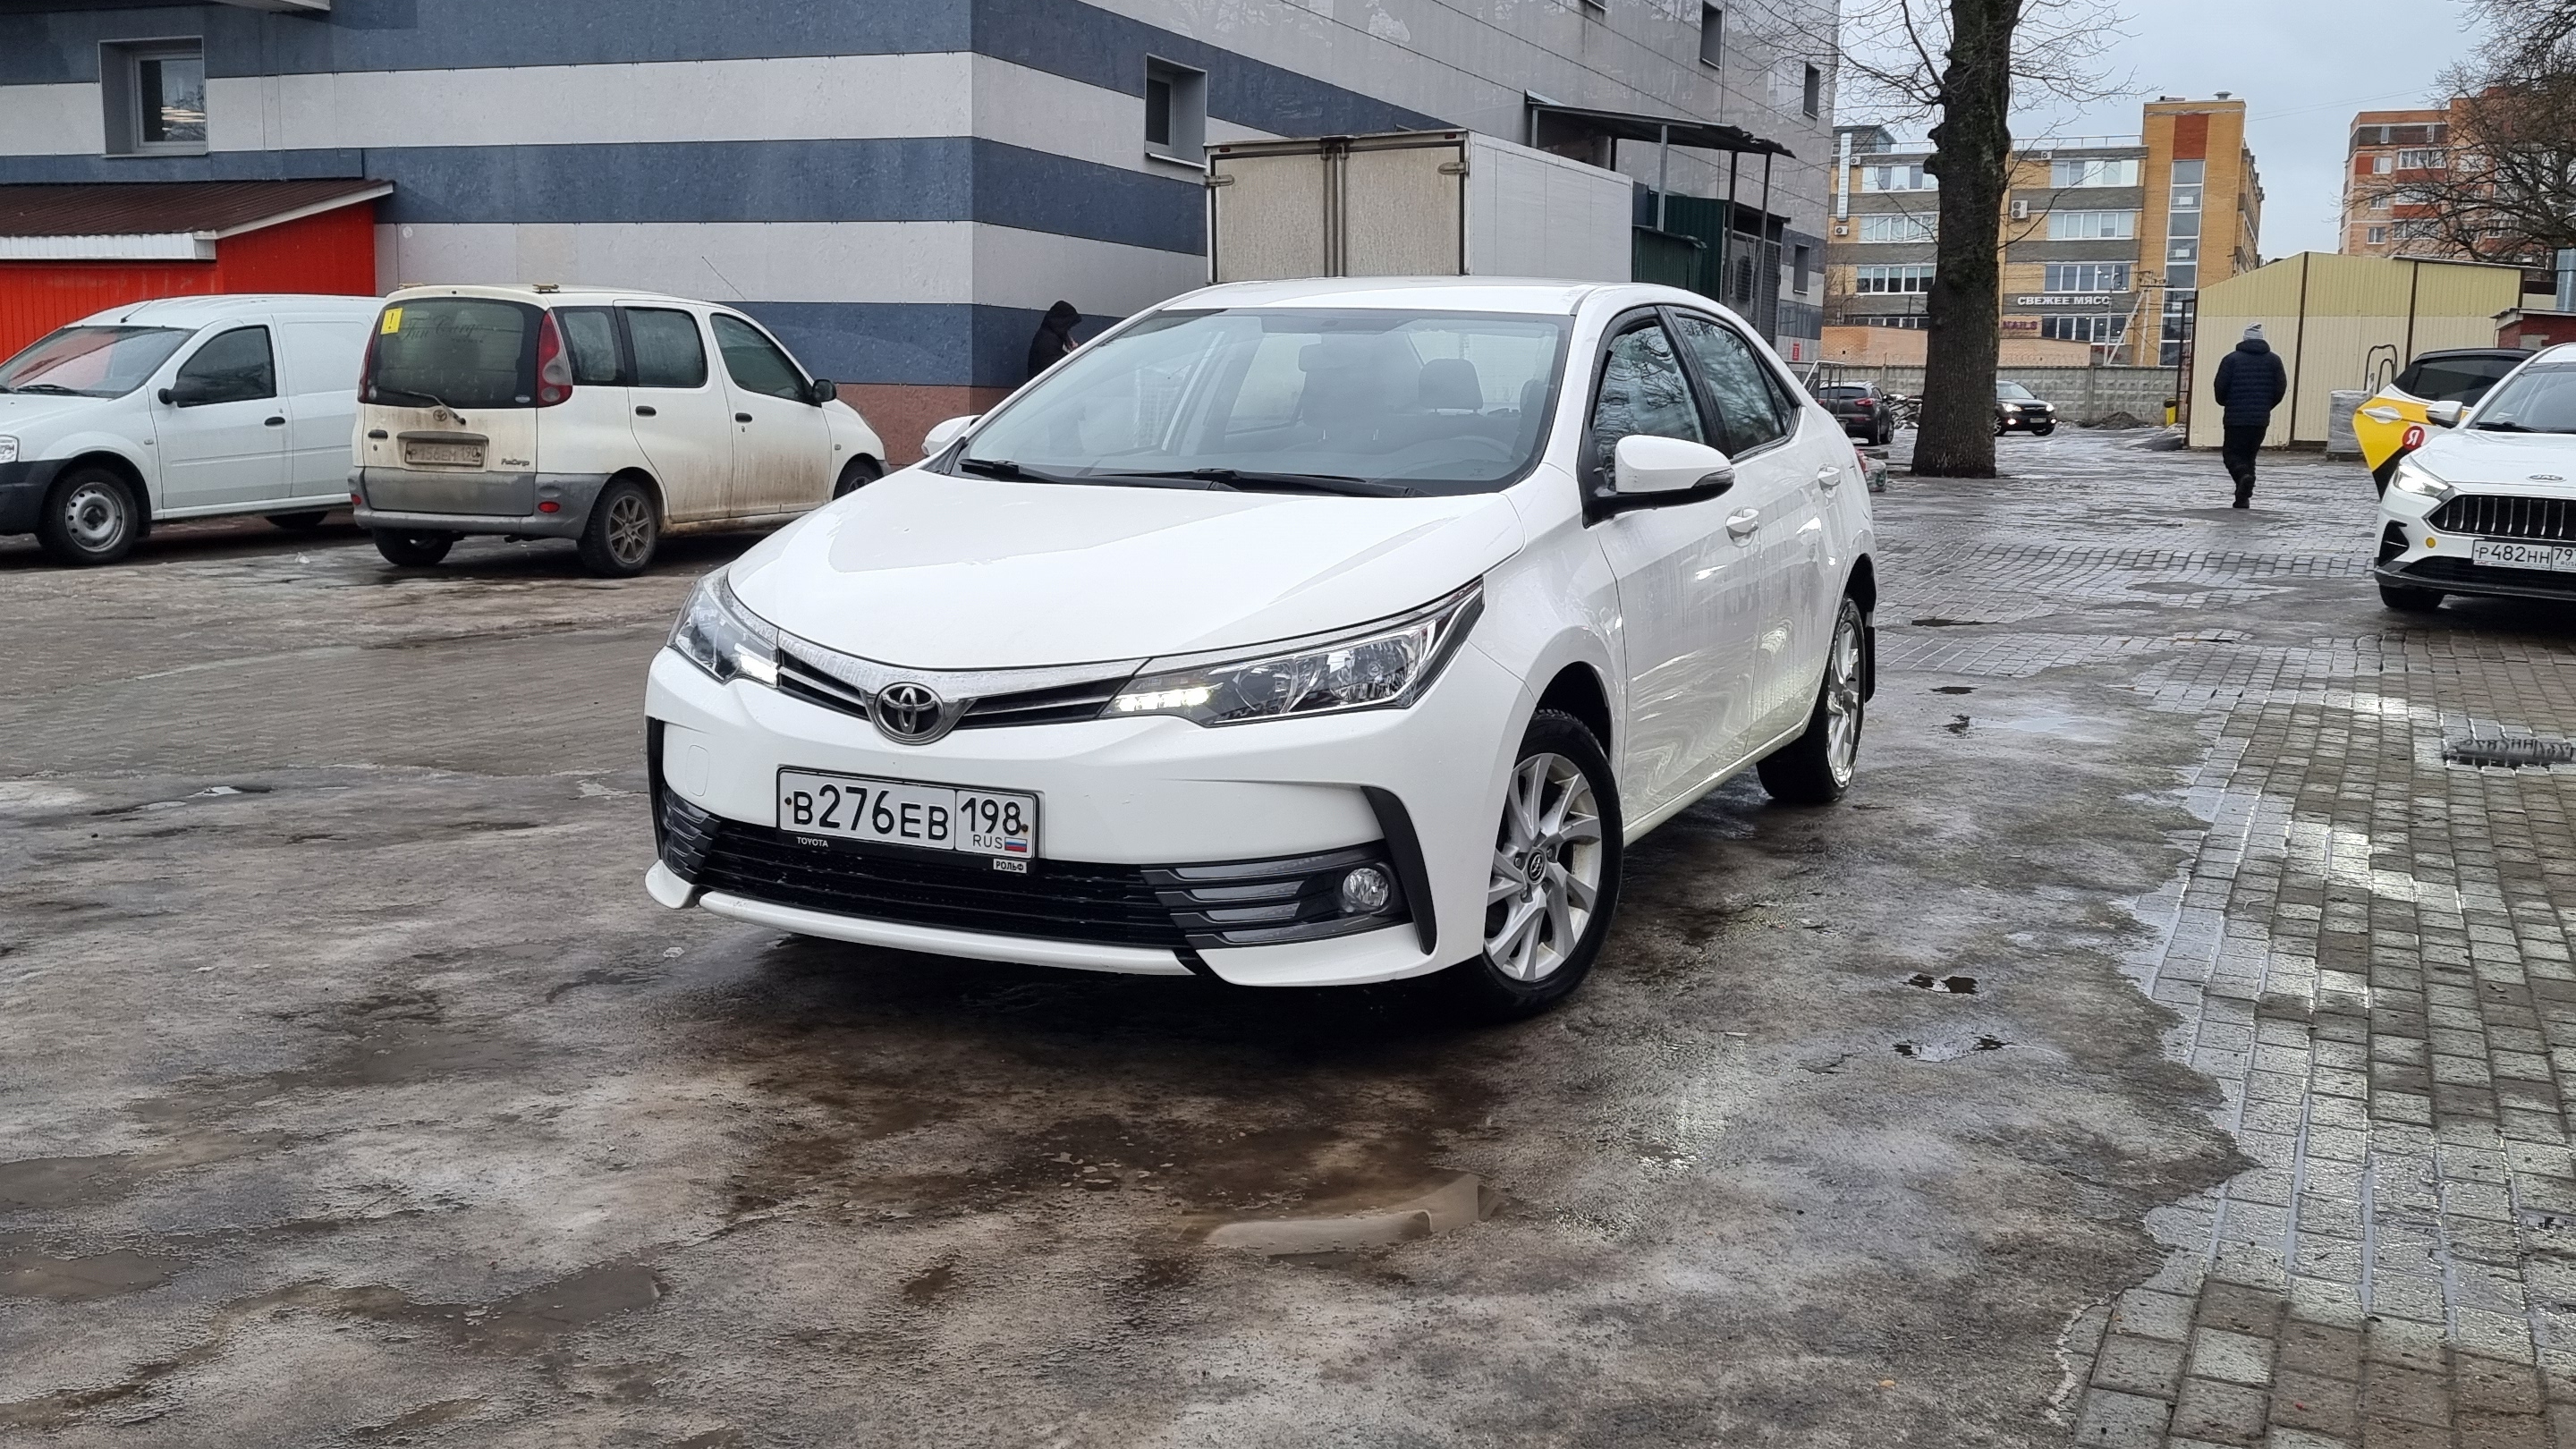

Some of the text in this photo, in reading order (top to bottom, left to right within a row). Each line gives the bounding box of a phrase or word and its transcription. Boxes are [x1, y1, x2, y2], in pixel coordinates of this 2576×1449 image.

[2017, 296, 2070, 305] СВЕЖЕЕ
[2003, 321, 2038, 330] NAILS
[2406, 429, 2420, 445] Я
[2479, 545, 2576, 564] Р482НН 79
[793, 784, 1021, 840] В276ЕВ 198
[797, 836, 828, 848] TOYOTA
[972, 834, 1003, 849] RUS
[996, 860, 1024, 872] РОЛЬФ
